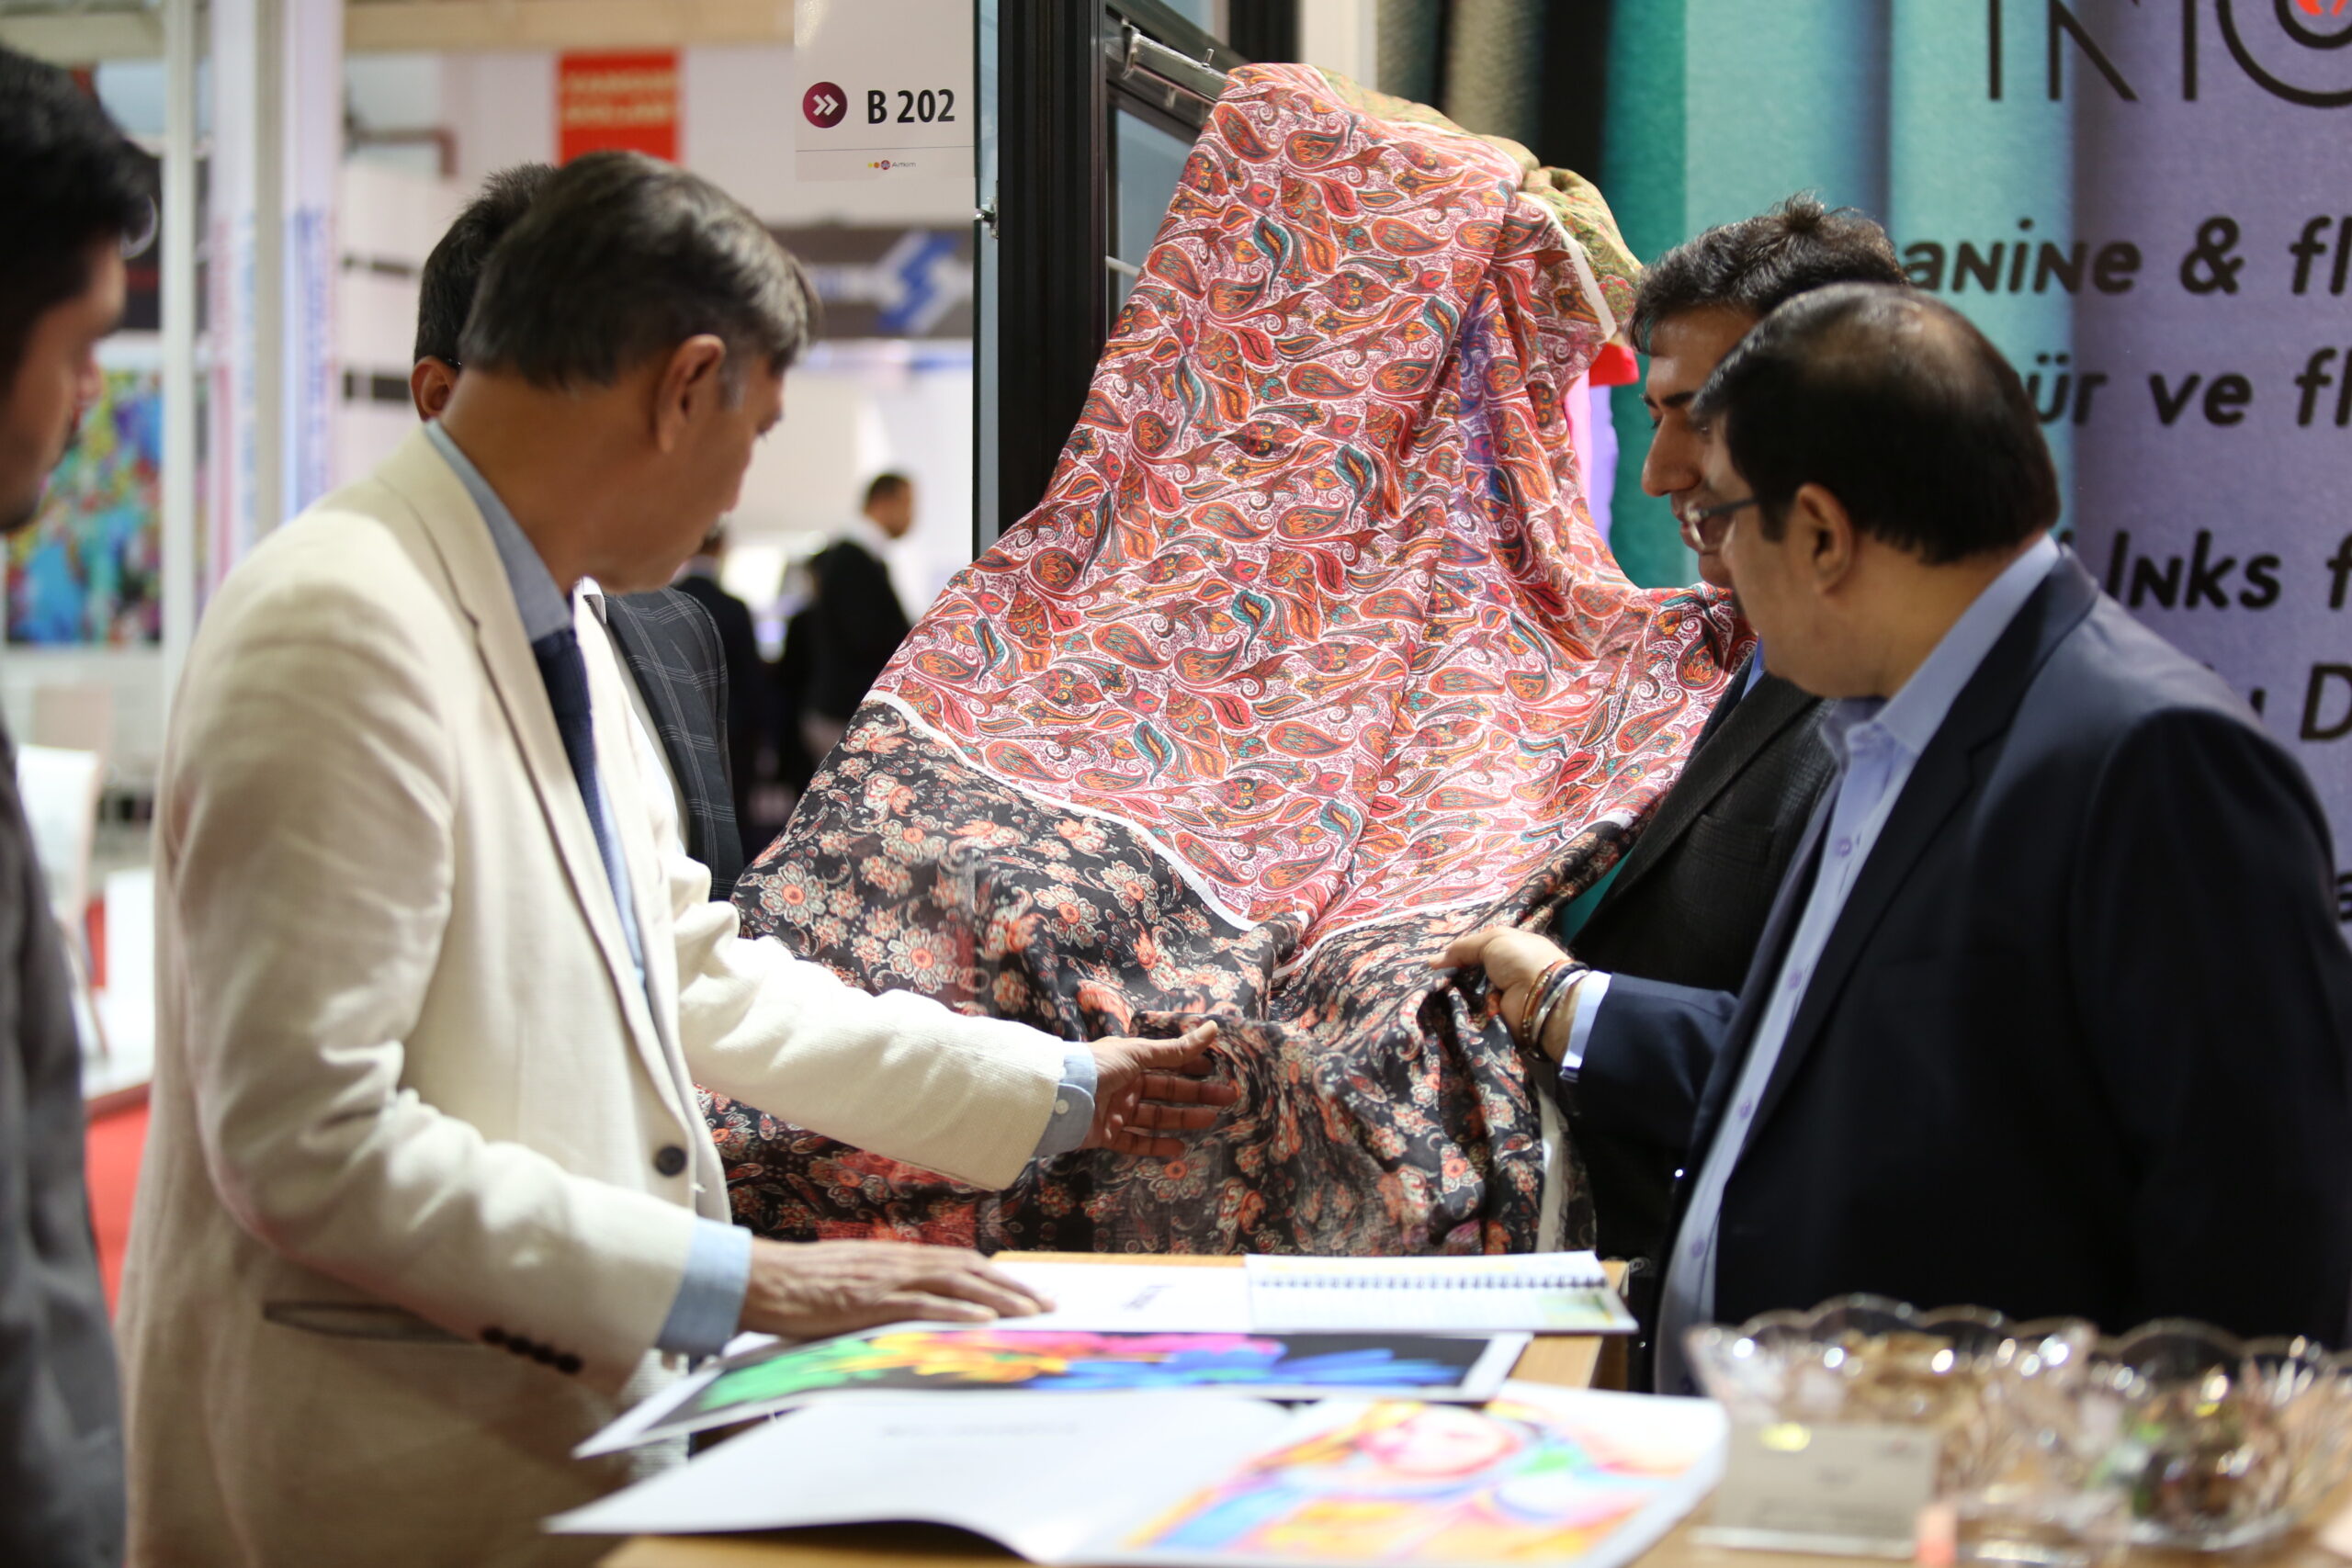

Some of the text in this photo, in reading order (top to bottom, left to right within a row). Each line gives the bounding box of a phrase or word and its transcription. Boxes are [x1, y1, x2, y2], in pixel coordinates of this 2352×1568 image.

[867, 89, 955, 124] B 202
[2178, 216, 2245, 295] &
[2149, 373, 2252, 426] ve
